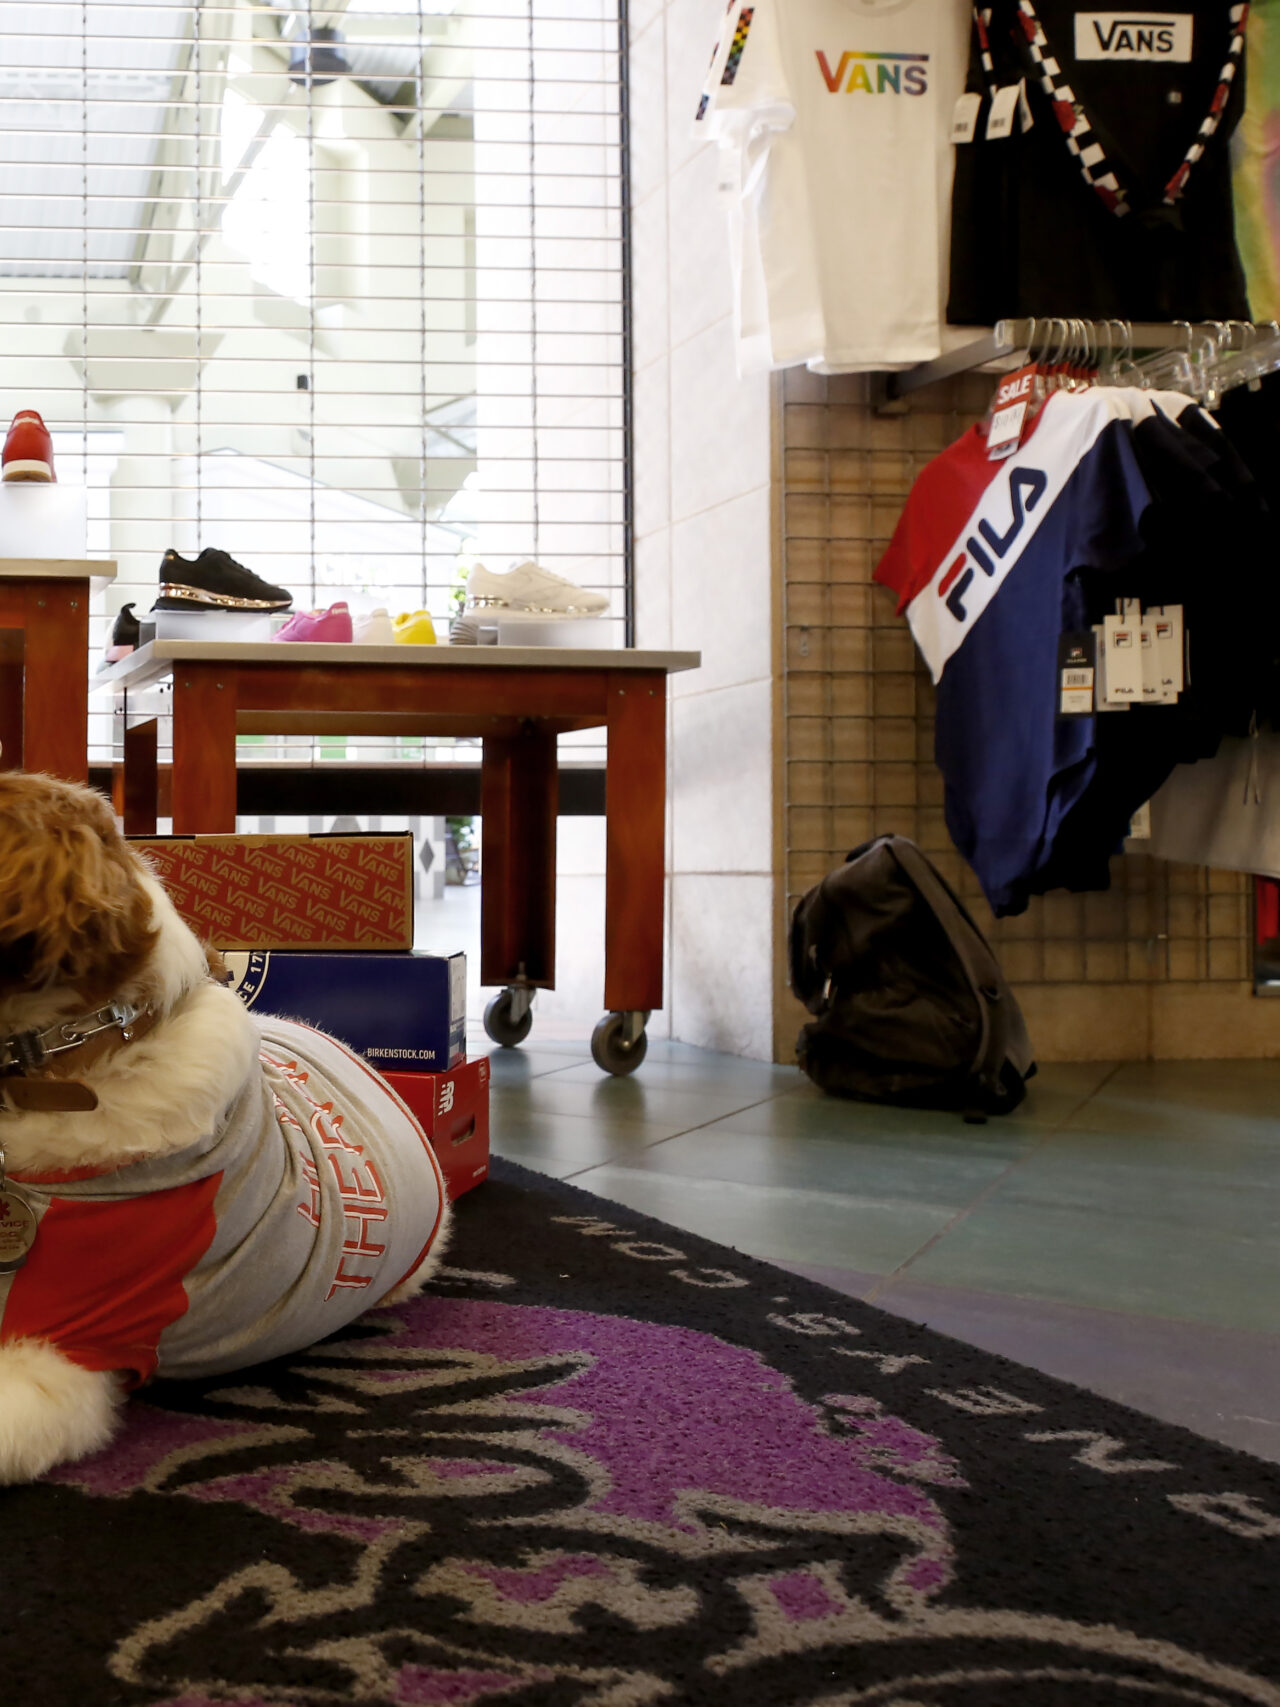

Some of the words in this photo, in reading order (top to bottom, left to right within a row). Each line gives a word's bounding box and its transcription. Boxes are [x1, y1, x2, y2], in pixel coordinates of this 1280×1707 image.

[1093, 20, 1176, 53] VANS
[815, 50, 930, 97] VANS
[997, 373, 1033, 405] SALE
[938, 467, 1047, 622] FILA
[325, 858, 368, 891] VANS
[373, 881, 406, 911] VAN
[358, 849, 402, 881] VANS
[180, 863, 222, 896] VANS
[227, 886, 269, 918] VANS
[273, 907, 316, 939] VANS
[193, 895, 235, 927] VANS
[211, 855, 254, 887] VANS
[257, 877, 301, 909] VANS
[306, 899, 349, 931] VANS
[291, 867, 334, 900] VANS
[339, 890, 384, 922] VANS
[367, 1047, 436, 1060] BIRKENSTOCK.COM
